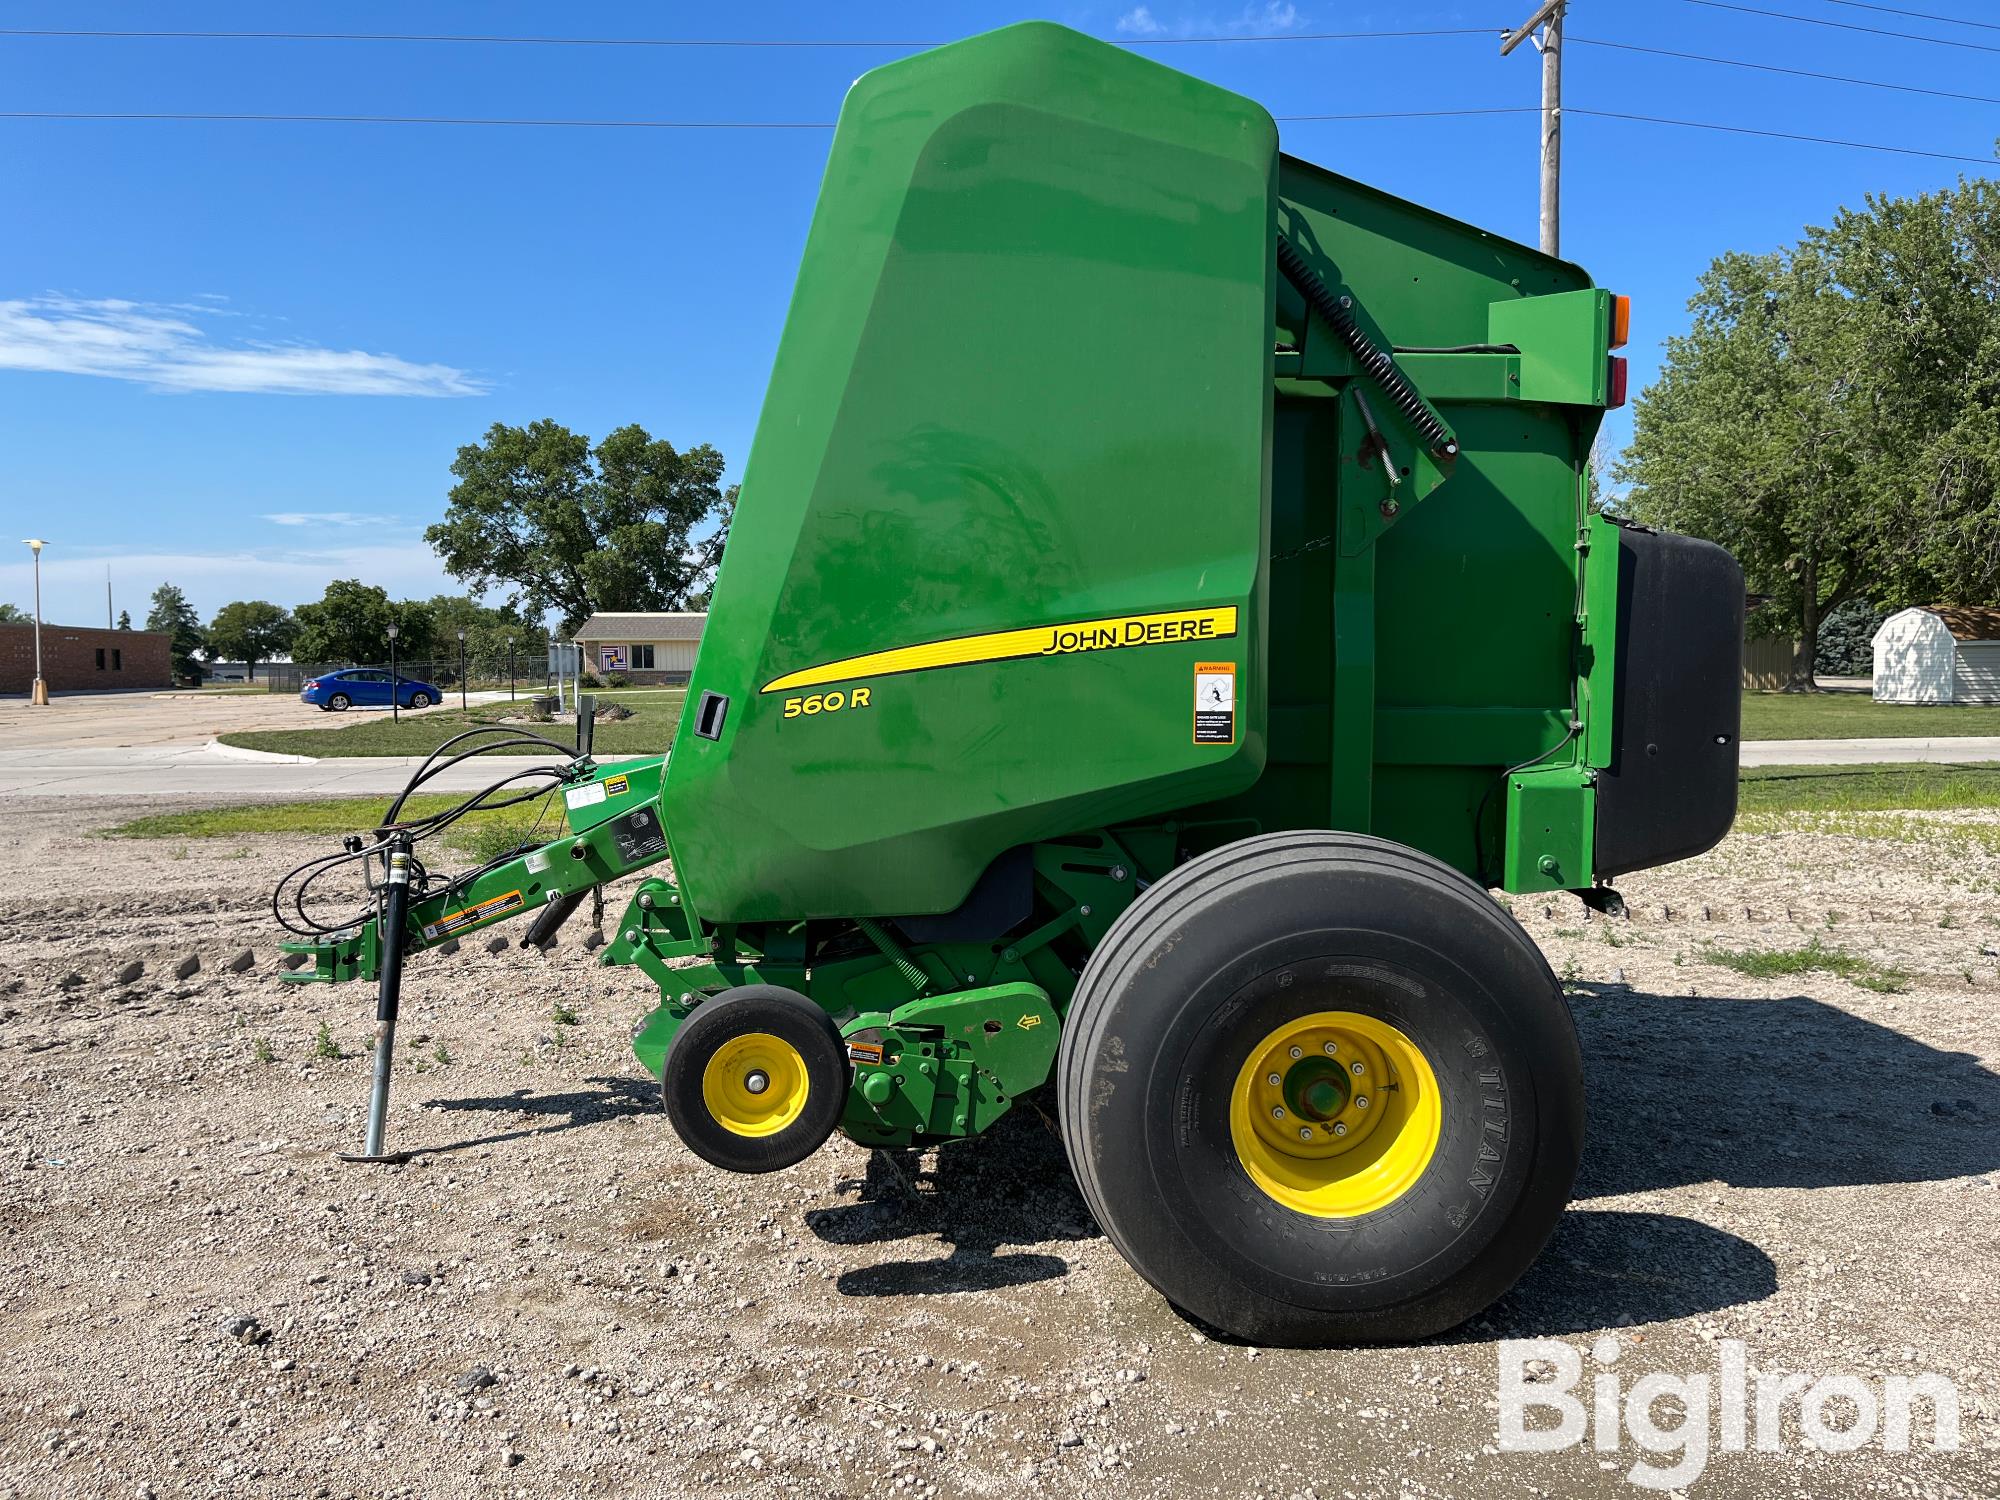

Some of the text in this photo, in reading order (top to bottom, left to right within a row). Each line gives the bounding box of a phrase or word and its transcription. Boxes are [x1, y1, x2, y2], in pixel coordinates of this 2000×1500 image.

[1043, 618, 1214, 651] JOHN DEERE
[783, 687, 871, 718] 560 R
[1467, 1067, 1508, 1200] TITAN
